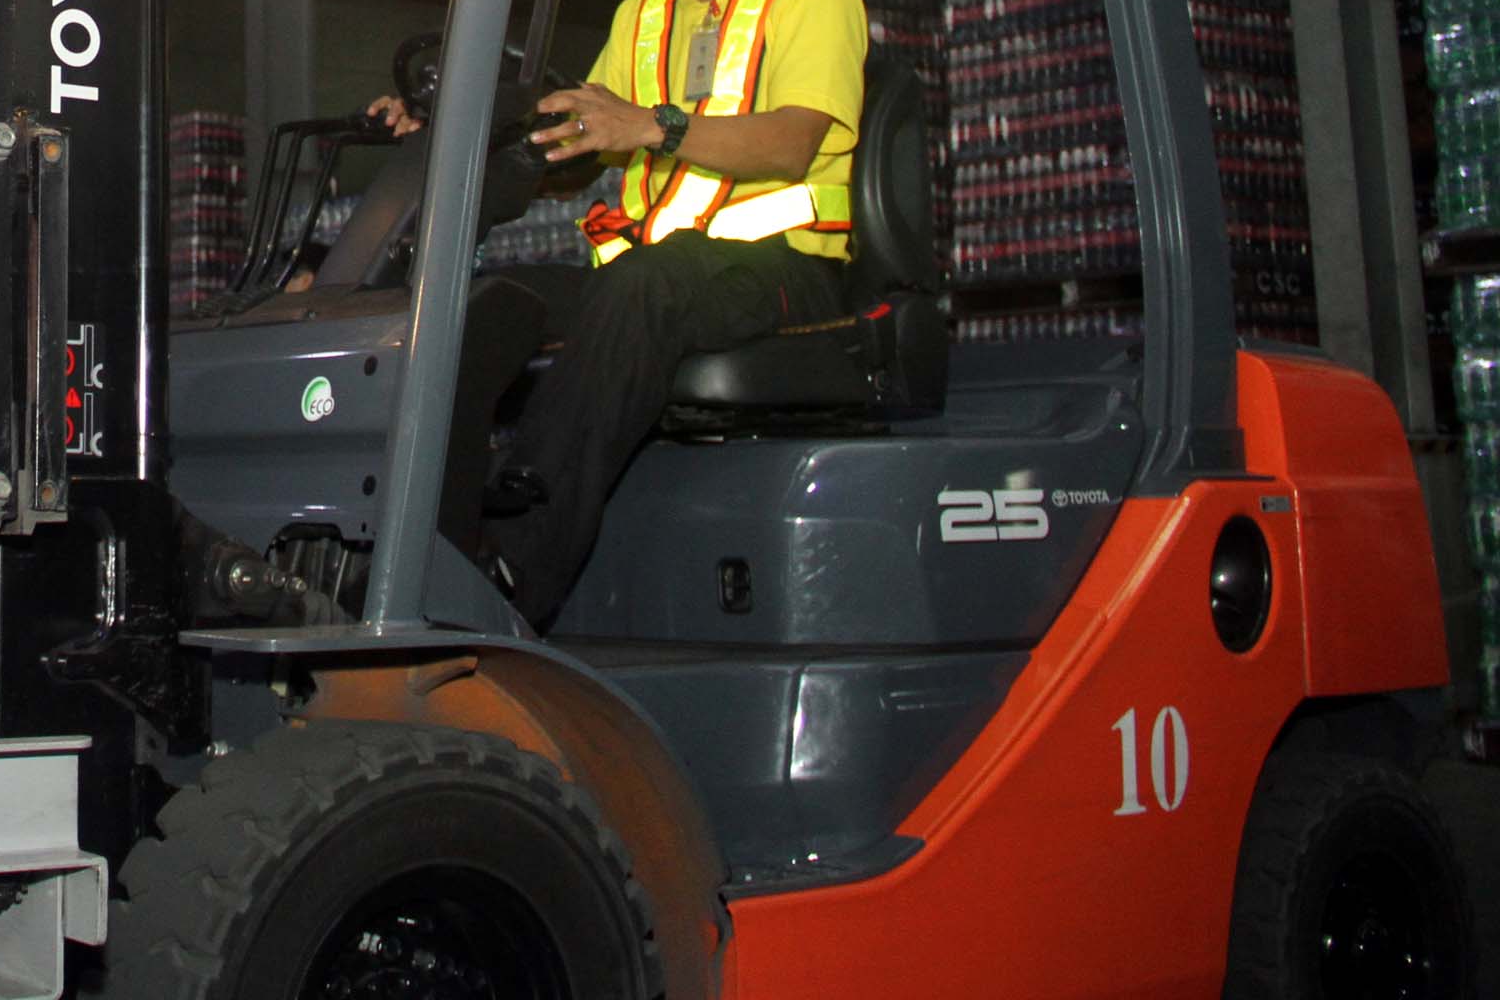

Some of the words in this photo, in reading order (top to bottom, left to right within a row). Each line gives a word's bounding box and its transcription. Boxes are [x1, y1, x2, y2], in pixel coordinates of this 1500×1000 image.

[937, 489, 1049, 542] 25
[1068, 489, 1110, 504] TOYOTA
[1111, 705, 1190, 816] 10
